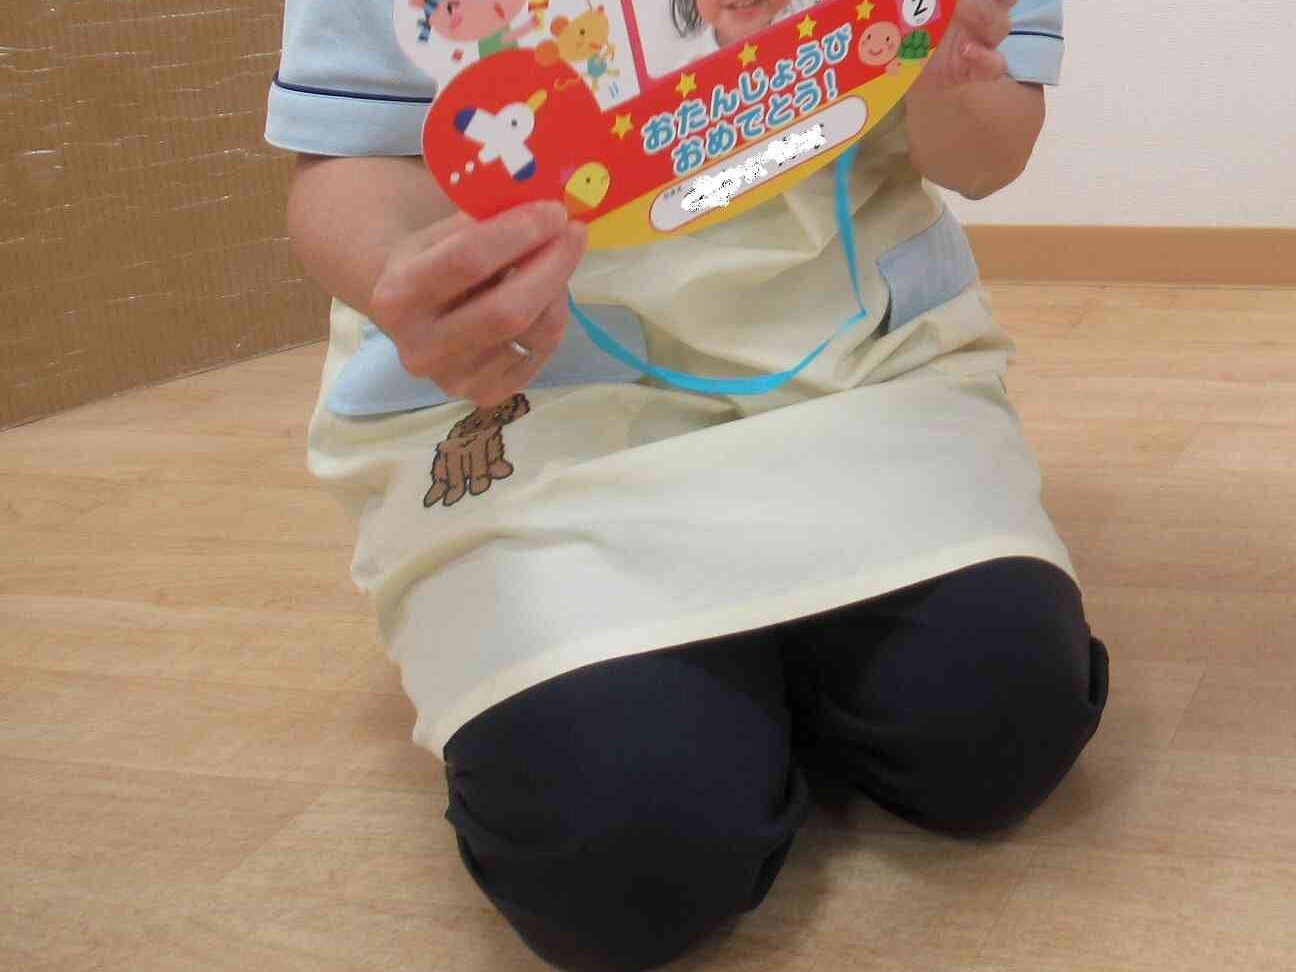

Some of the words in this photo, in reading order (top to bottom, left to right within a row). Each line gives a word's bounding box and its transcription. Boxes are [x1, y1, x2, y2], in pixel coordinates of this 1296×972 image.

[642, 24, 852, 152] おたんじょうび
